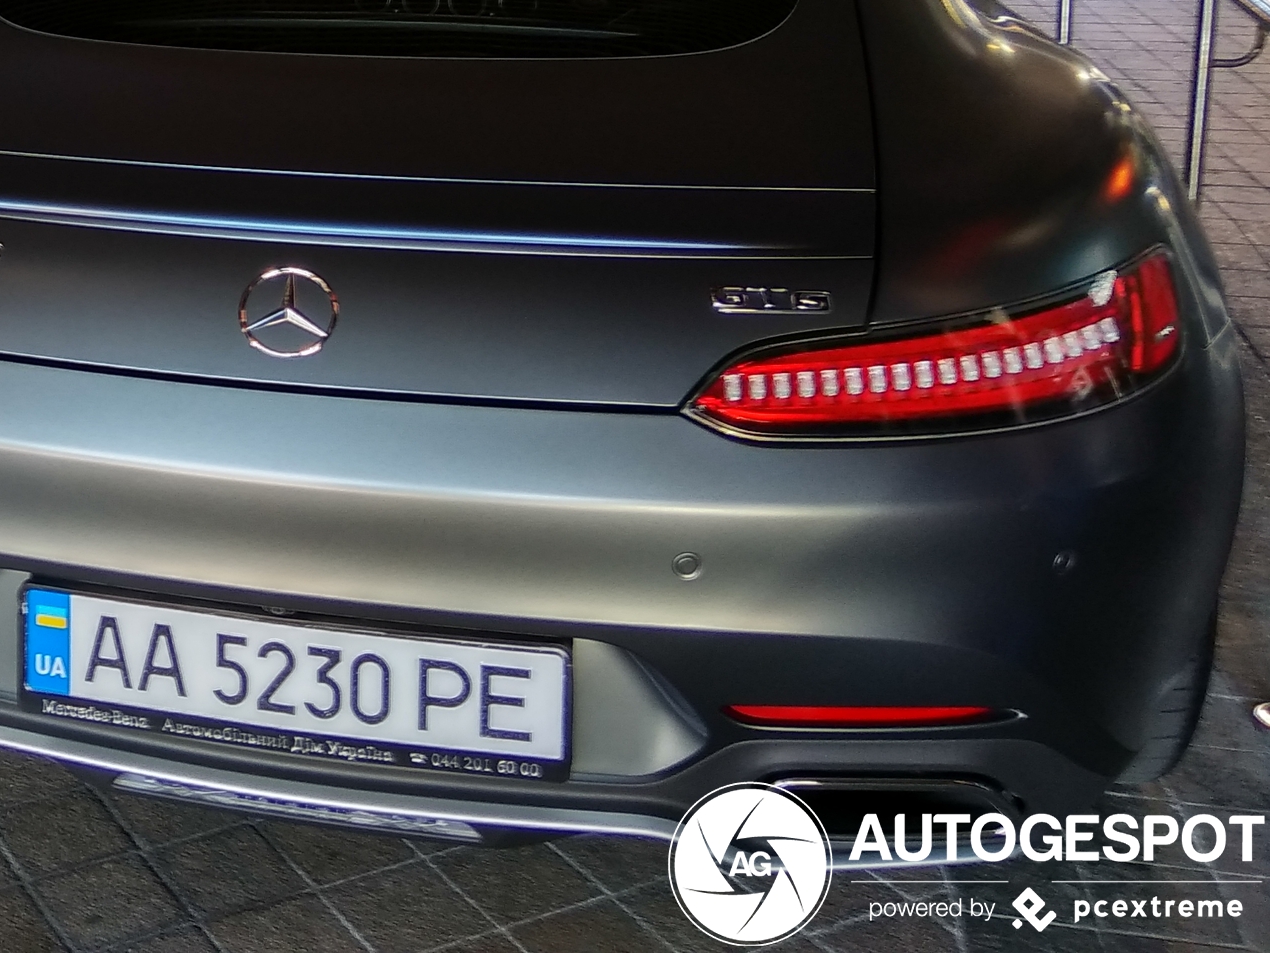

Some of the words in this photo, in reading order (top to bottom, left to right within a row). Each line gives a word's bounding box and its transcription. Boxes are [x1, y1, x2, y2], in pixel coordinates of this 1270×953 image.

[35, 653, 68, 678] UA
[84, 615, 188, 697] AA
[212, 632, 392, 725] 5230
[417, 657, 533, 742] PE
[41, 699, 151, 729] Mercedes-Benz
[431, 752, 461, 768] 044
[463, 756, 493, 772] 201
[496, 759, 518, 775] 60
[519, 762, 544, 778] 00
